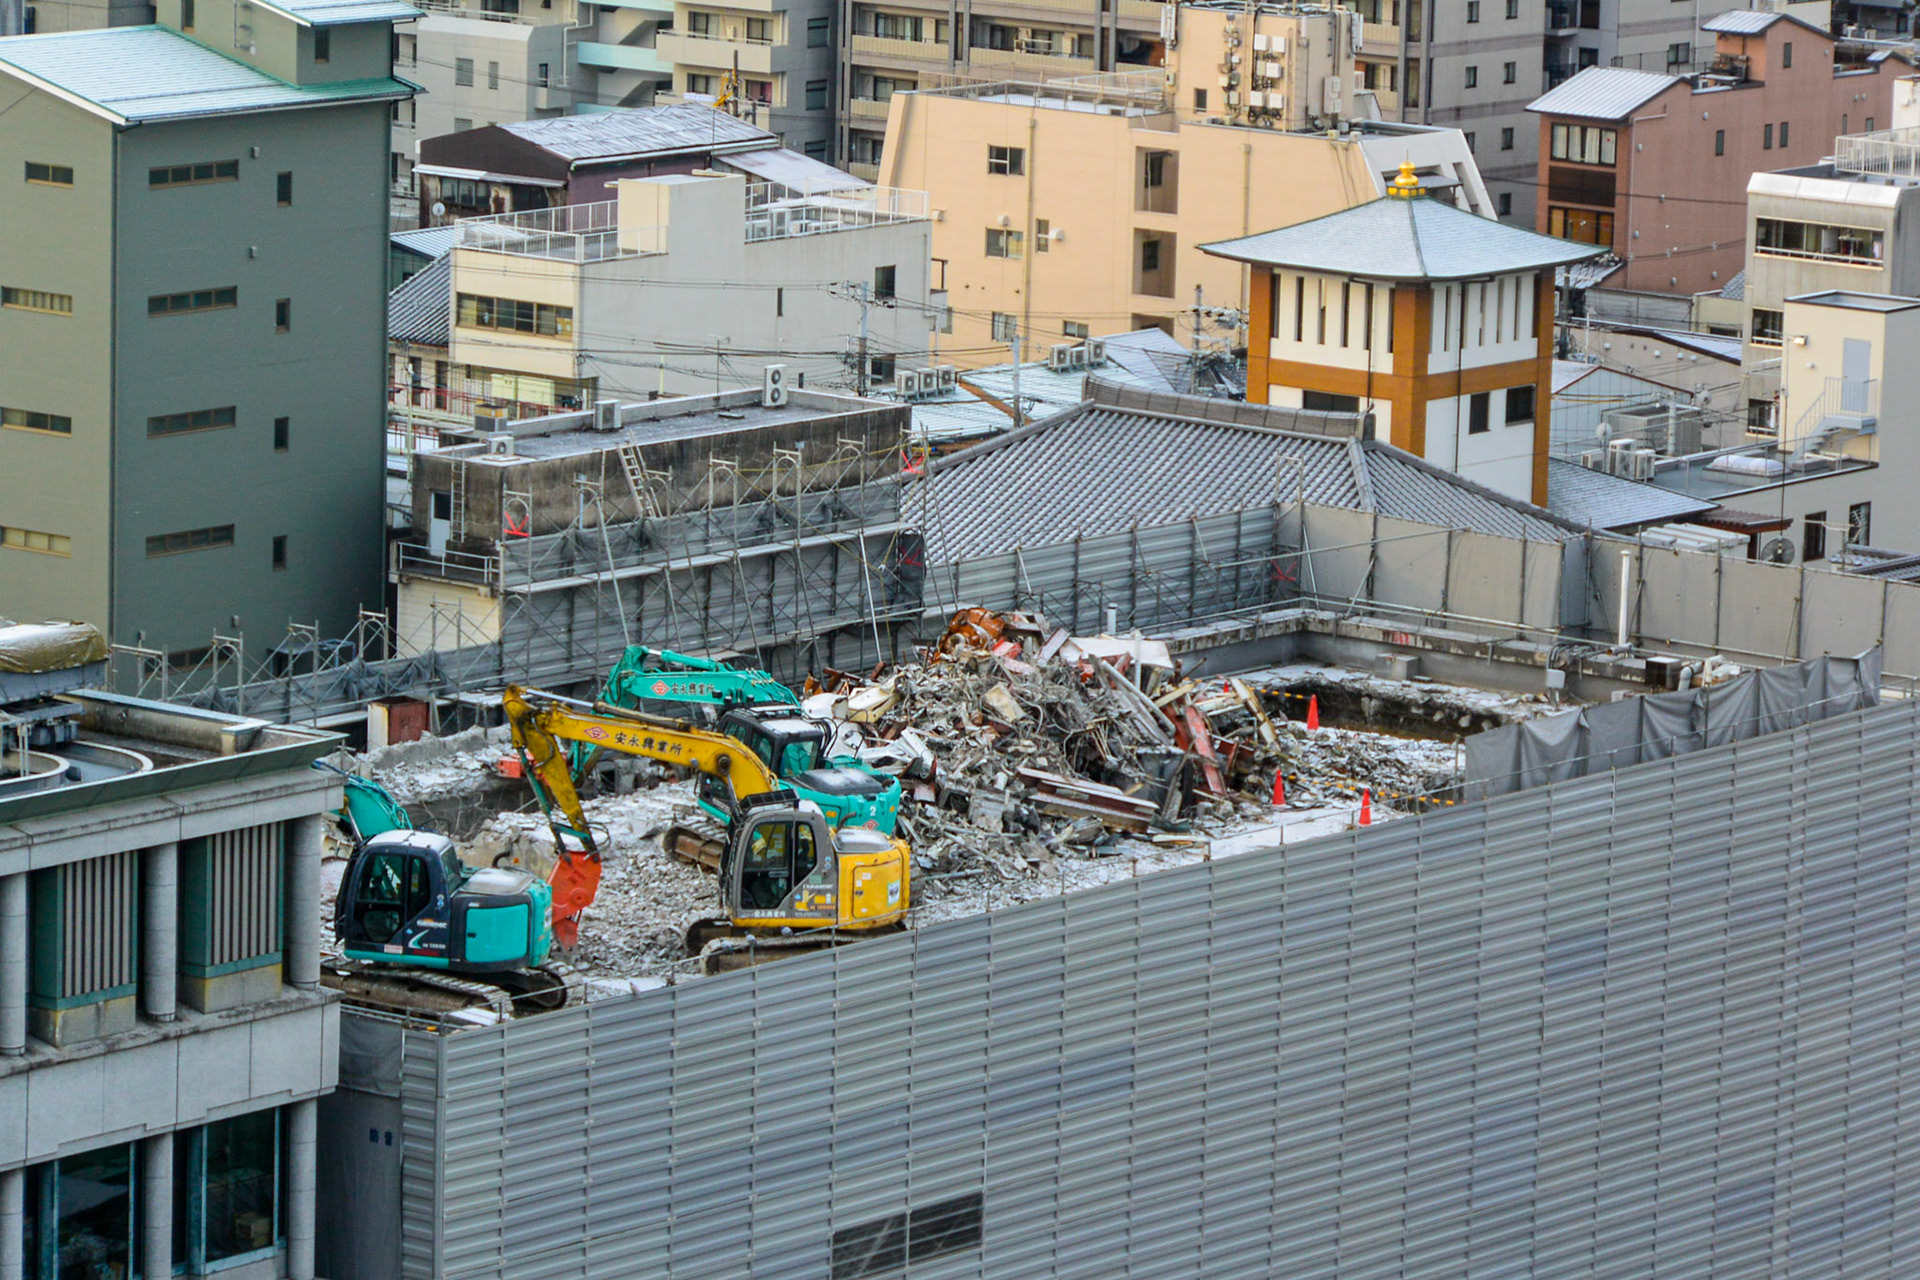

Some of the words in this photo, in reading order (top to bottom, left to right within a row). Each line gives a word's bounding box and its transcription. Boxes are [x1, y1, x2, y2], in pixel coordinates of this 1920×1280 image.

[614, 731, 684, 757] 安永興業所
[869, 805, 877, 817] 2
